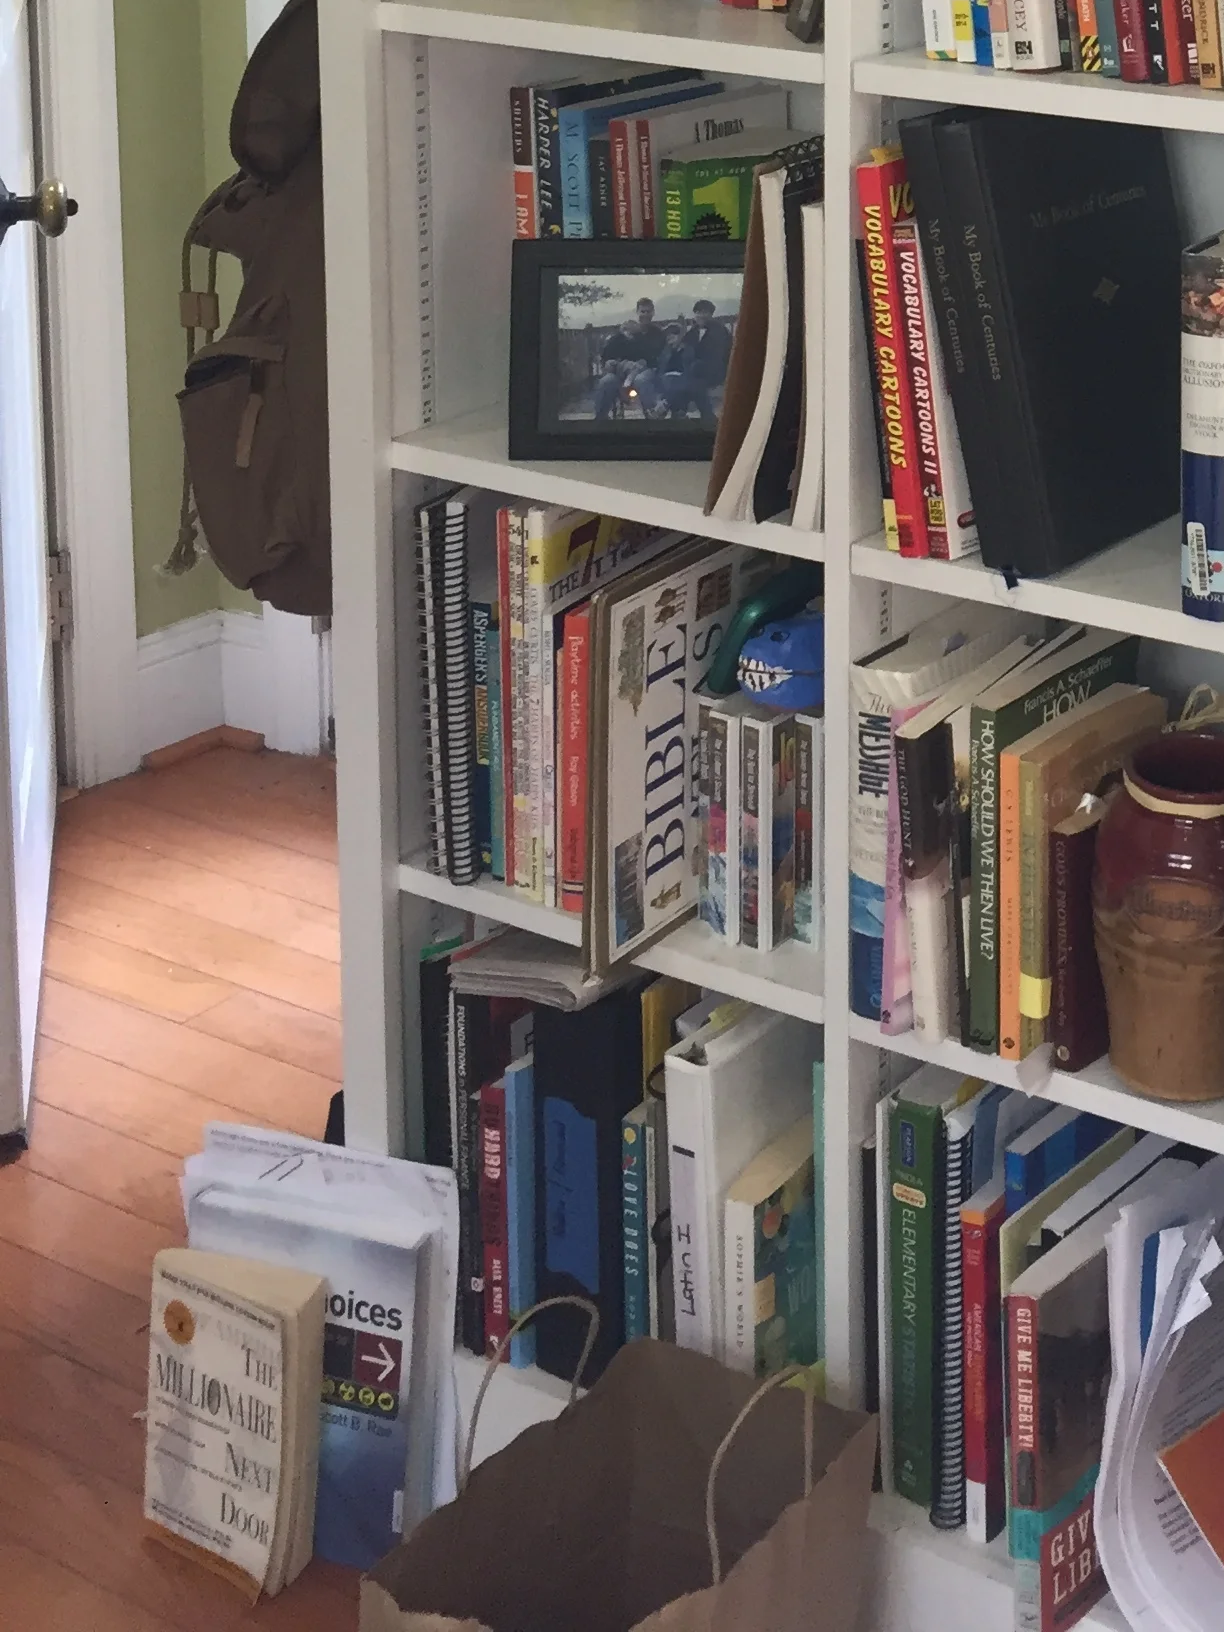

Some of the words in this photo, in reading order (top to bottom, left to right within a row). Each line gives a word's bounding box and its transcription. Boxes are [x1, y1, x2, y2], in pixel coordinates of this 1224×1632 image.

[536, 96, 551, 169] HARPER
[540, 178, 553, 210] LEE
[863, 204, 894, 340] VOCABULARY
[899, 250, 926, 362] VOCABULARY
[968, 250, 985, 292] Book
[980, 311, 1002, 382] Centuries
[878, 345, 908, 469] CARTOONS
[912, 365, 937, 457] CARTOONS
[923, 458, 938, 475] II
[645, 622, 687, 885] BIBLE
[980, 718, 995, 765] HOW
[980, 767, 996, 834] SHOULD
[980, 835, 996, 866] WE
[980, 869, 995, 914] THEN
[980, 915, 995, 961] LIVE?
[901, 1206, 922, 1327] ELEMENTARY
[1016, 1307, 1033, 1344] GIVE
[1016, 1349, 1033, 1371] ME
